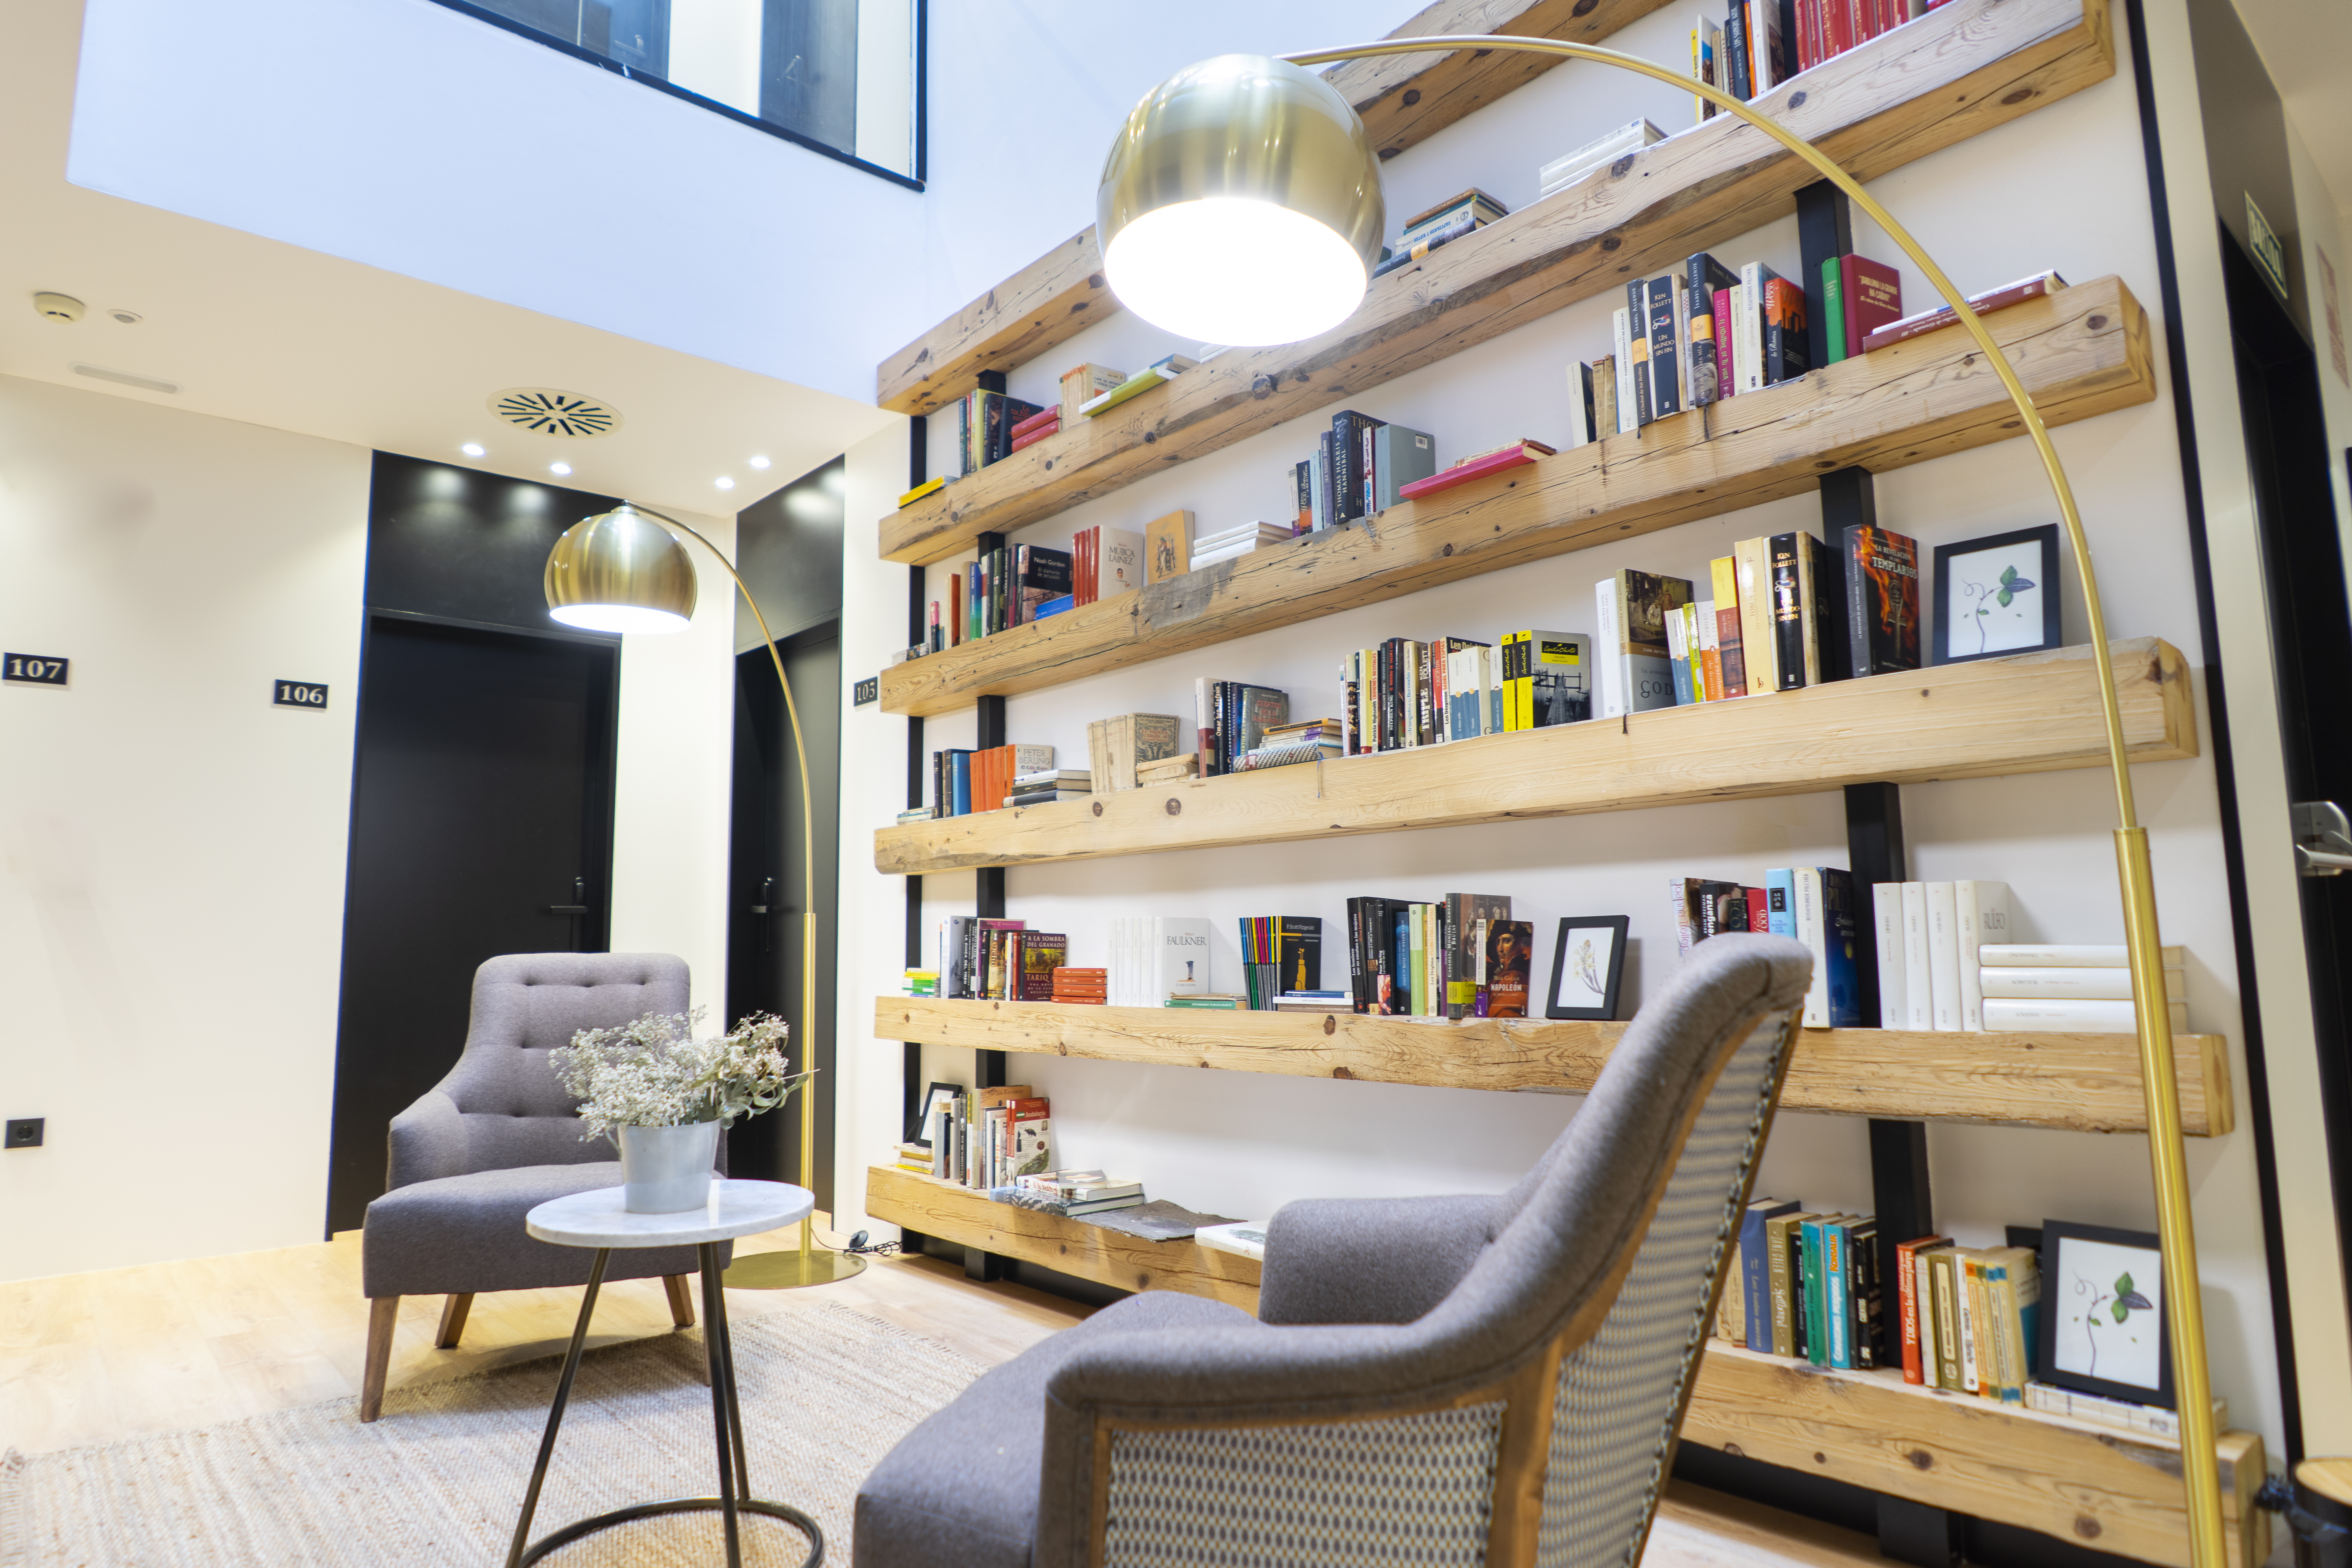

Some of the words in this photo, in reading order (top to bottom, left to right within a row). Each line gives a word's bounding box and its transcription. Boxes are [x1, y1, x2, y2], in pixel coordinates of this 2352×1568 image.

[1731, 18, 1741, 38] SANGRE
[1690, 263, 1699, 287] ALLENDE
[1650, 298, 1672, 310] FOLLETT
[1654, 292, 1666, 301] KEN
[1719, 326, 1727, 350] HOMBRE
[1746, 316, 1757, 348] Septiembre
[1653, 339, 1675, 350] MUNDO
[1655, 348, 1665, 357] SIN
[1109, 546, 1135, 557] MUJICA
[1109, 554, 1133, 565] LAINEZ
[1034, 556, 1046, 564] Noah
[1047, 559, 1065, 568] Gordon
[1772, 559, 1797, 568] FOLLETT
[1872, 557, 1917, 579] TEMPLARIOS
[1776, 606, 1800, 614] MUNDO
[1450, 640, 1461, 650] Len
[9, 658, 63, 679] 107
[1714, 665, 1724, 698] punishment
[280, 684, 323, 704] 106
[856, 682, 875, 701] 105
[1257, 700, 1281, 709] CUENTOS
[1420, 688, 1430, 731] TRIPLE
[1253, 715, 1283, 725] ALHAMBRA
[1673, 882, 1686, 918] Joanna
[1706, 894, 1716, 936] venganza
[1167, 936, 1207, 946] FAULKNER
[1491, 982, 1522, 991] NAPOLEÓN
[1033, 1180, 1058, 1194] ESPAÑA
[1770, 1235, 1784, 1253] JANE
[1828, 1234, 1838, 1272] KONSALIK
[1771, 1253, 1785, 1274] GREEN
[1904, 1252, 1912, 1273] playa
[1772, 1288, 1788, 1328] Spellbound
[1908, 1307, 1913, 1316] en
